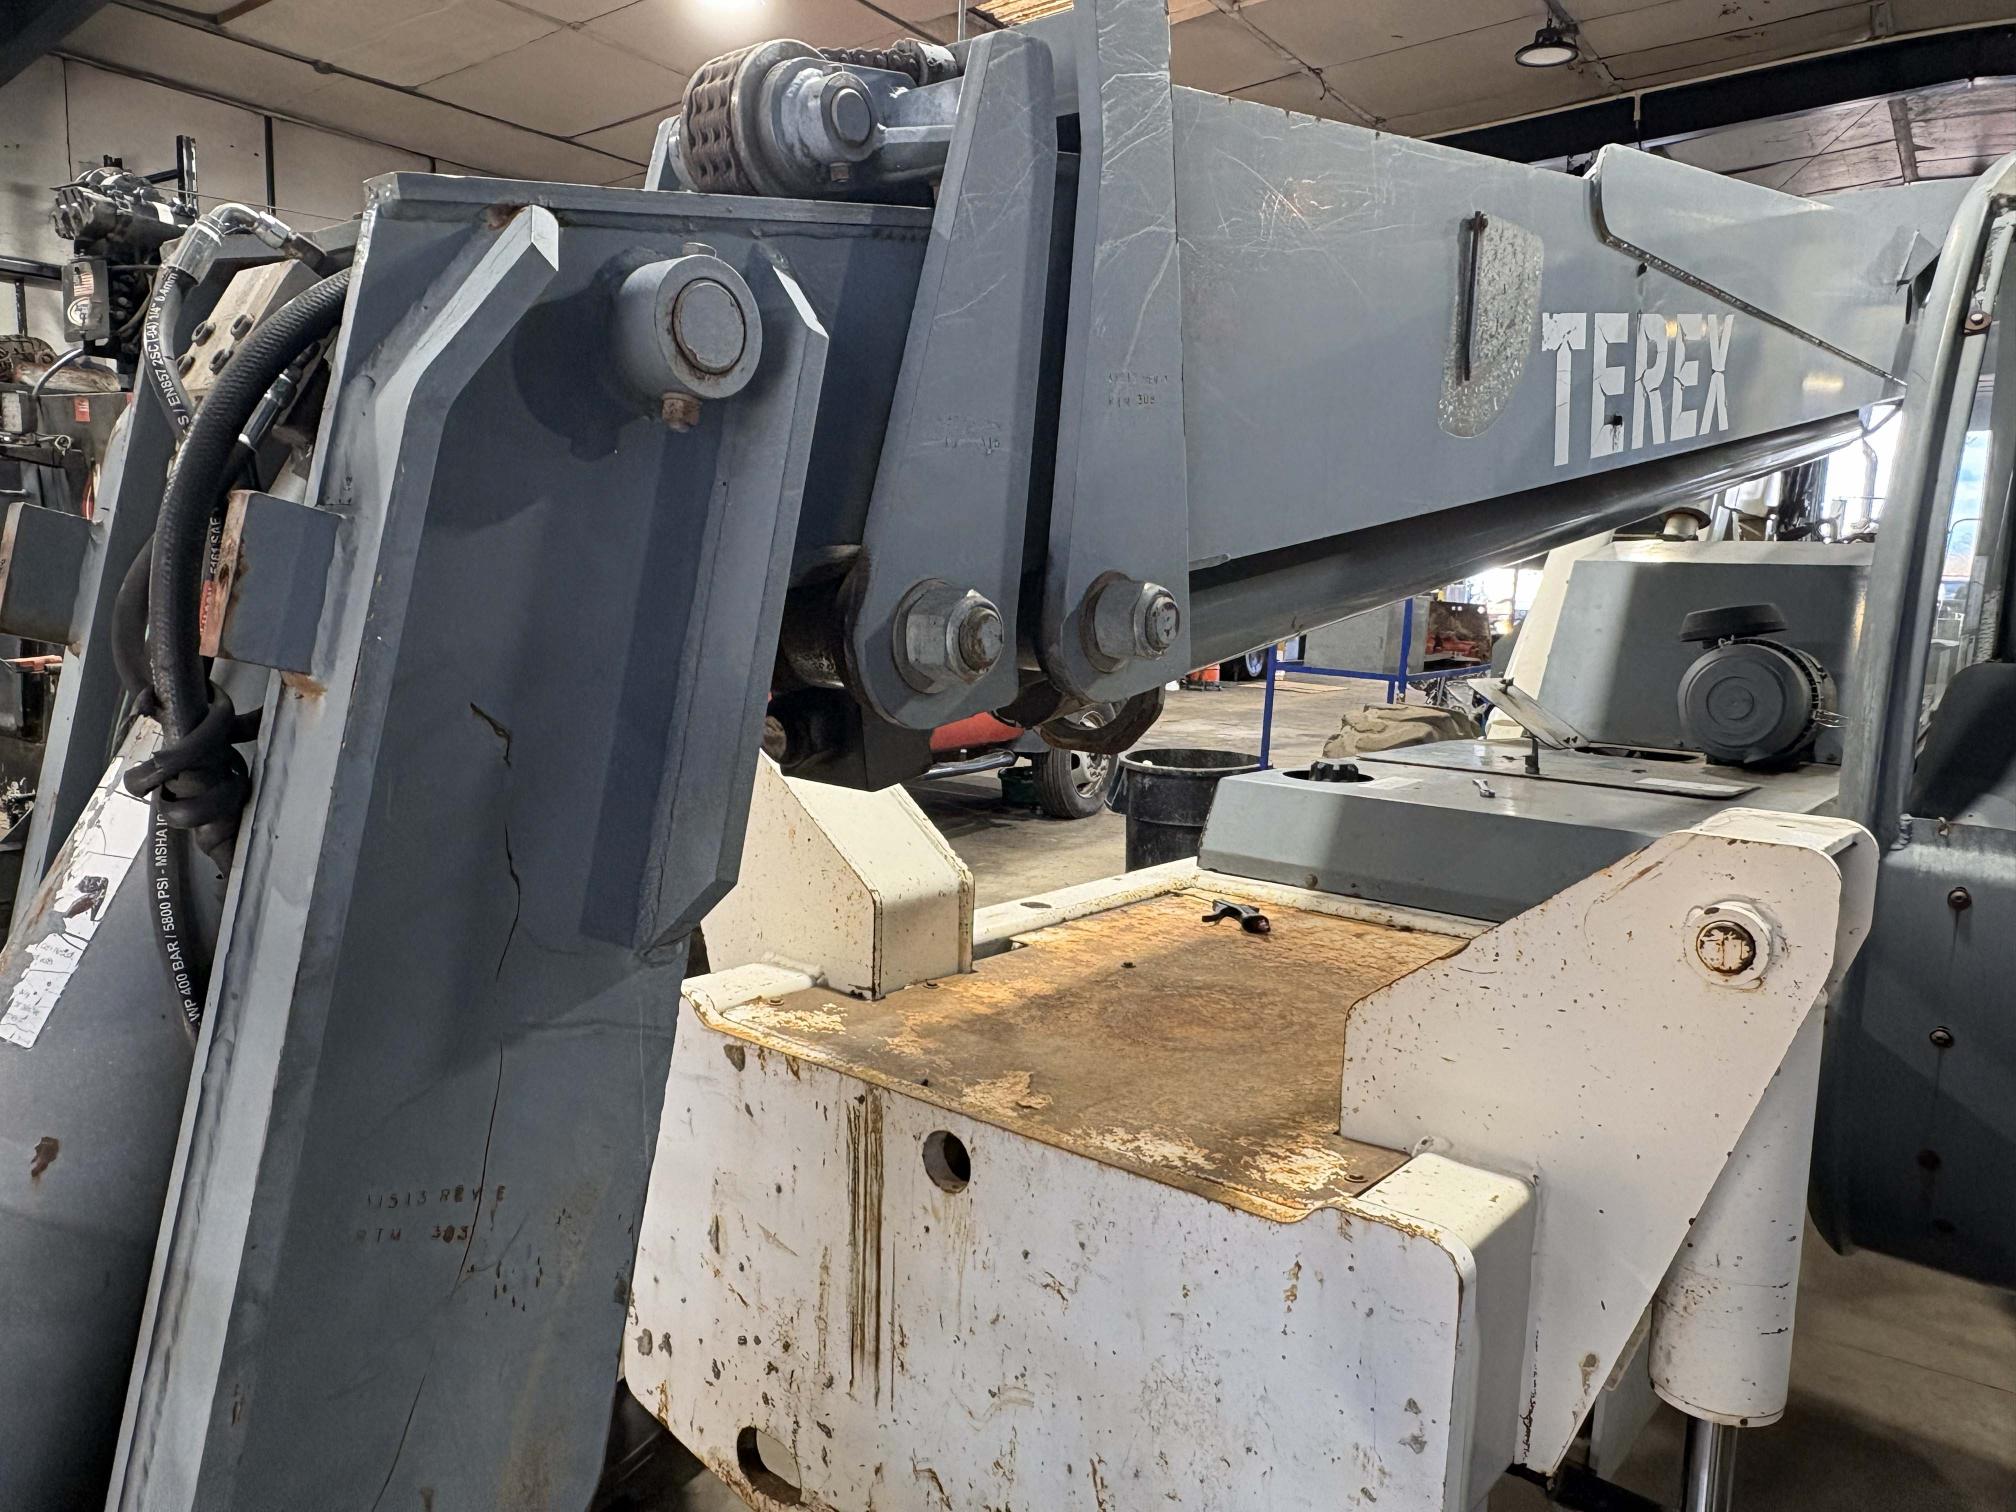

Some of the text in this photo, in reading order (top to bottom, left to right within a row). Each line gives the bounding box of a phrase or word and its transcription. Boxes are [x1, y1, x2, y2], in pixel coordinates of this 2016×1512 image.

[149, 344, 164, 367] 2SC
[154, 368, 181, 407] EN857
[1541, 312, 1735, 467] TEREX
[155, 829, 168, 866] MSHA
[156, 877, 170, 899] PSI
[159, 902, 175, 931] 5800
[167, 940, 185, 972] BAR
[176, 973, 191, 995] 400
[184, 999, 200, 1021] WP
